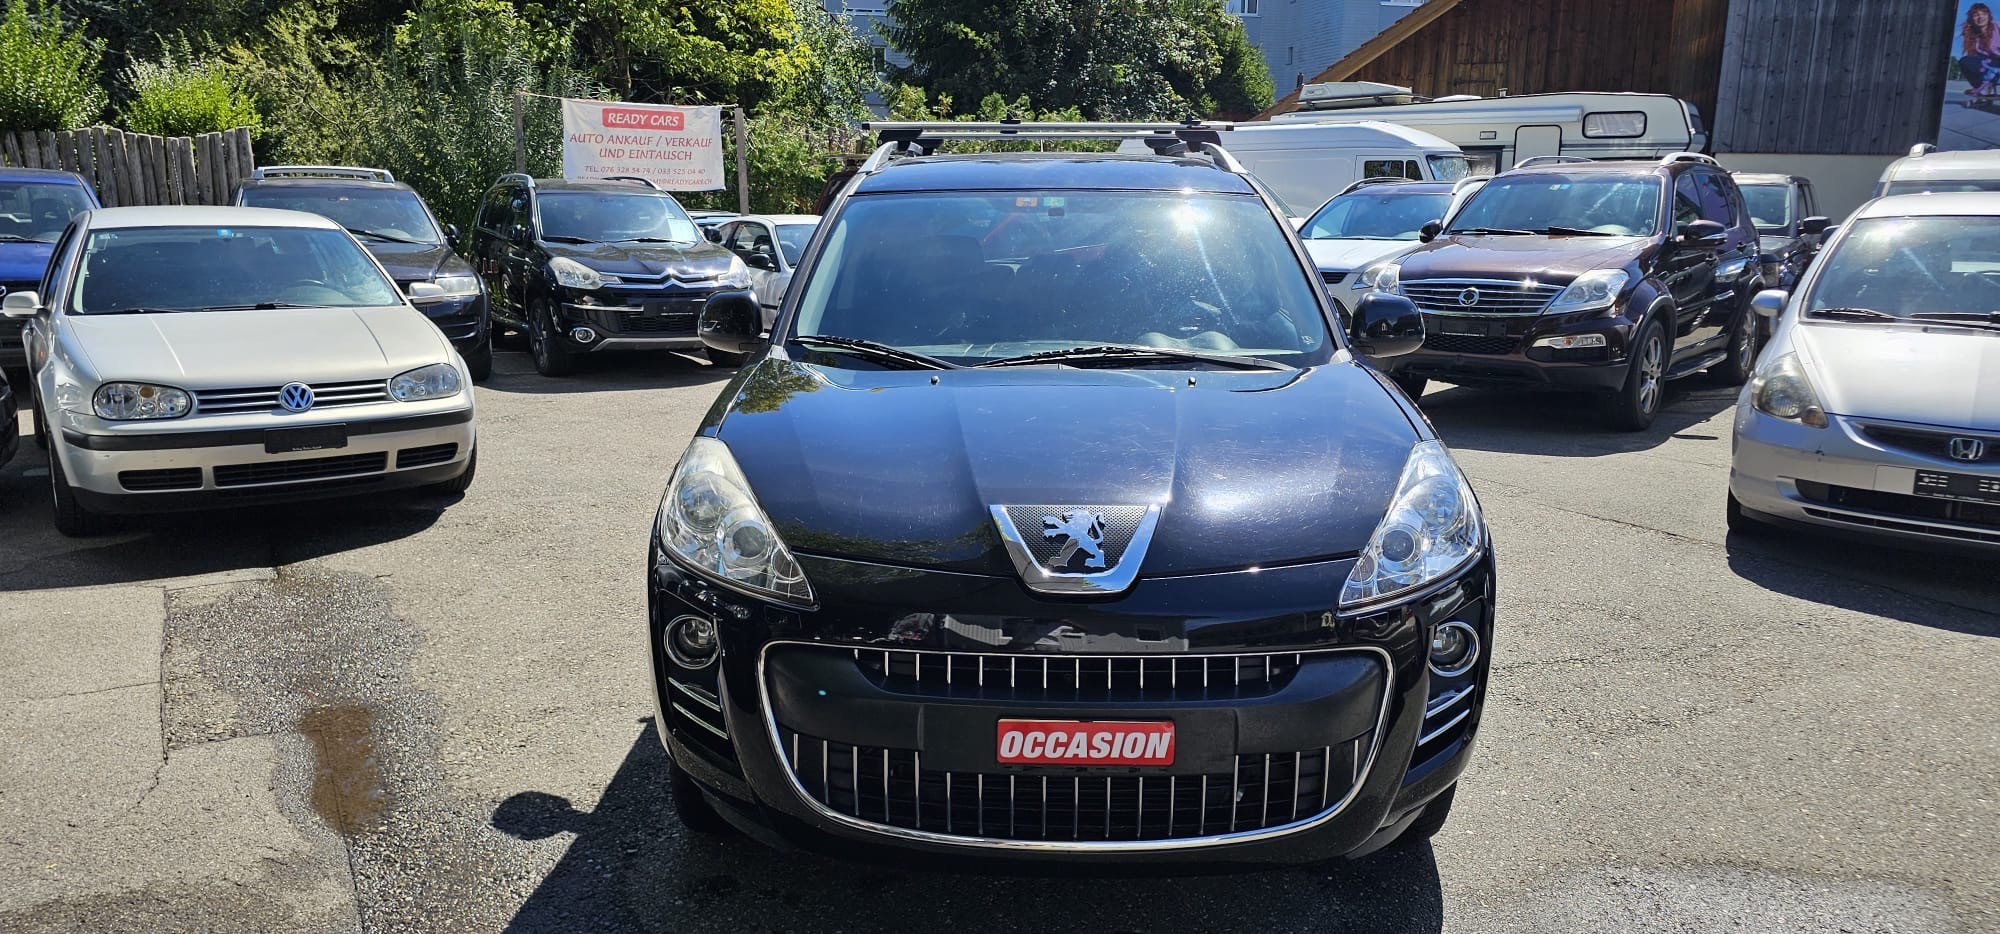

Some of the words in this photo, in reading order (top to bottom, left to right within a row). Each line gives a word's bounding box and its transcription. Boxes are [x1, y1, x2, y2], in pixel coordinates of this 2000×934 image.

[607, 112, 647, 125] READY
[650, 115, 679, 127] CARS
[569, 133, 604, 144] AUTO
[607, 135, 653, 146] ANKAUF
[655, 136, 662, 148] /
[665, 137, 713, 148] VERKAUF
[599, 148, 625, 159] UND
[628, 149, 693, 161] EINTAUSCH
[600, 166, 615, 174] 076
[1000, 730, 1172, 759] OCCASION
